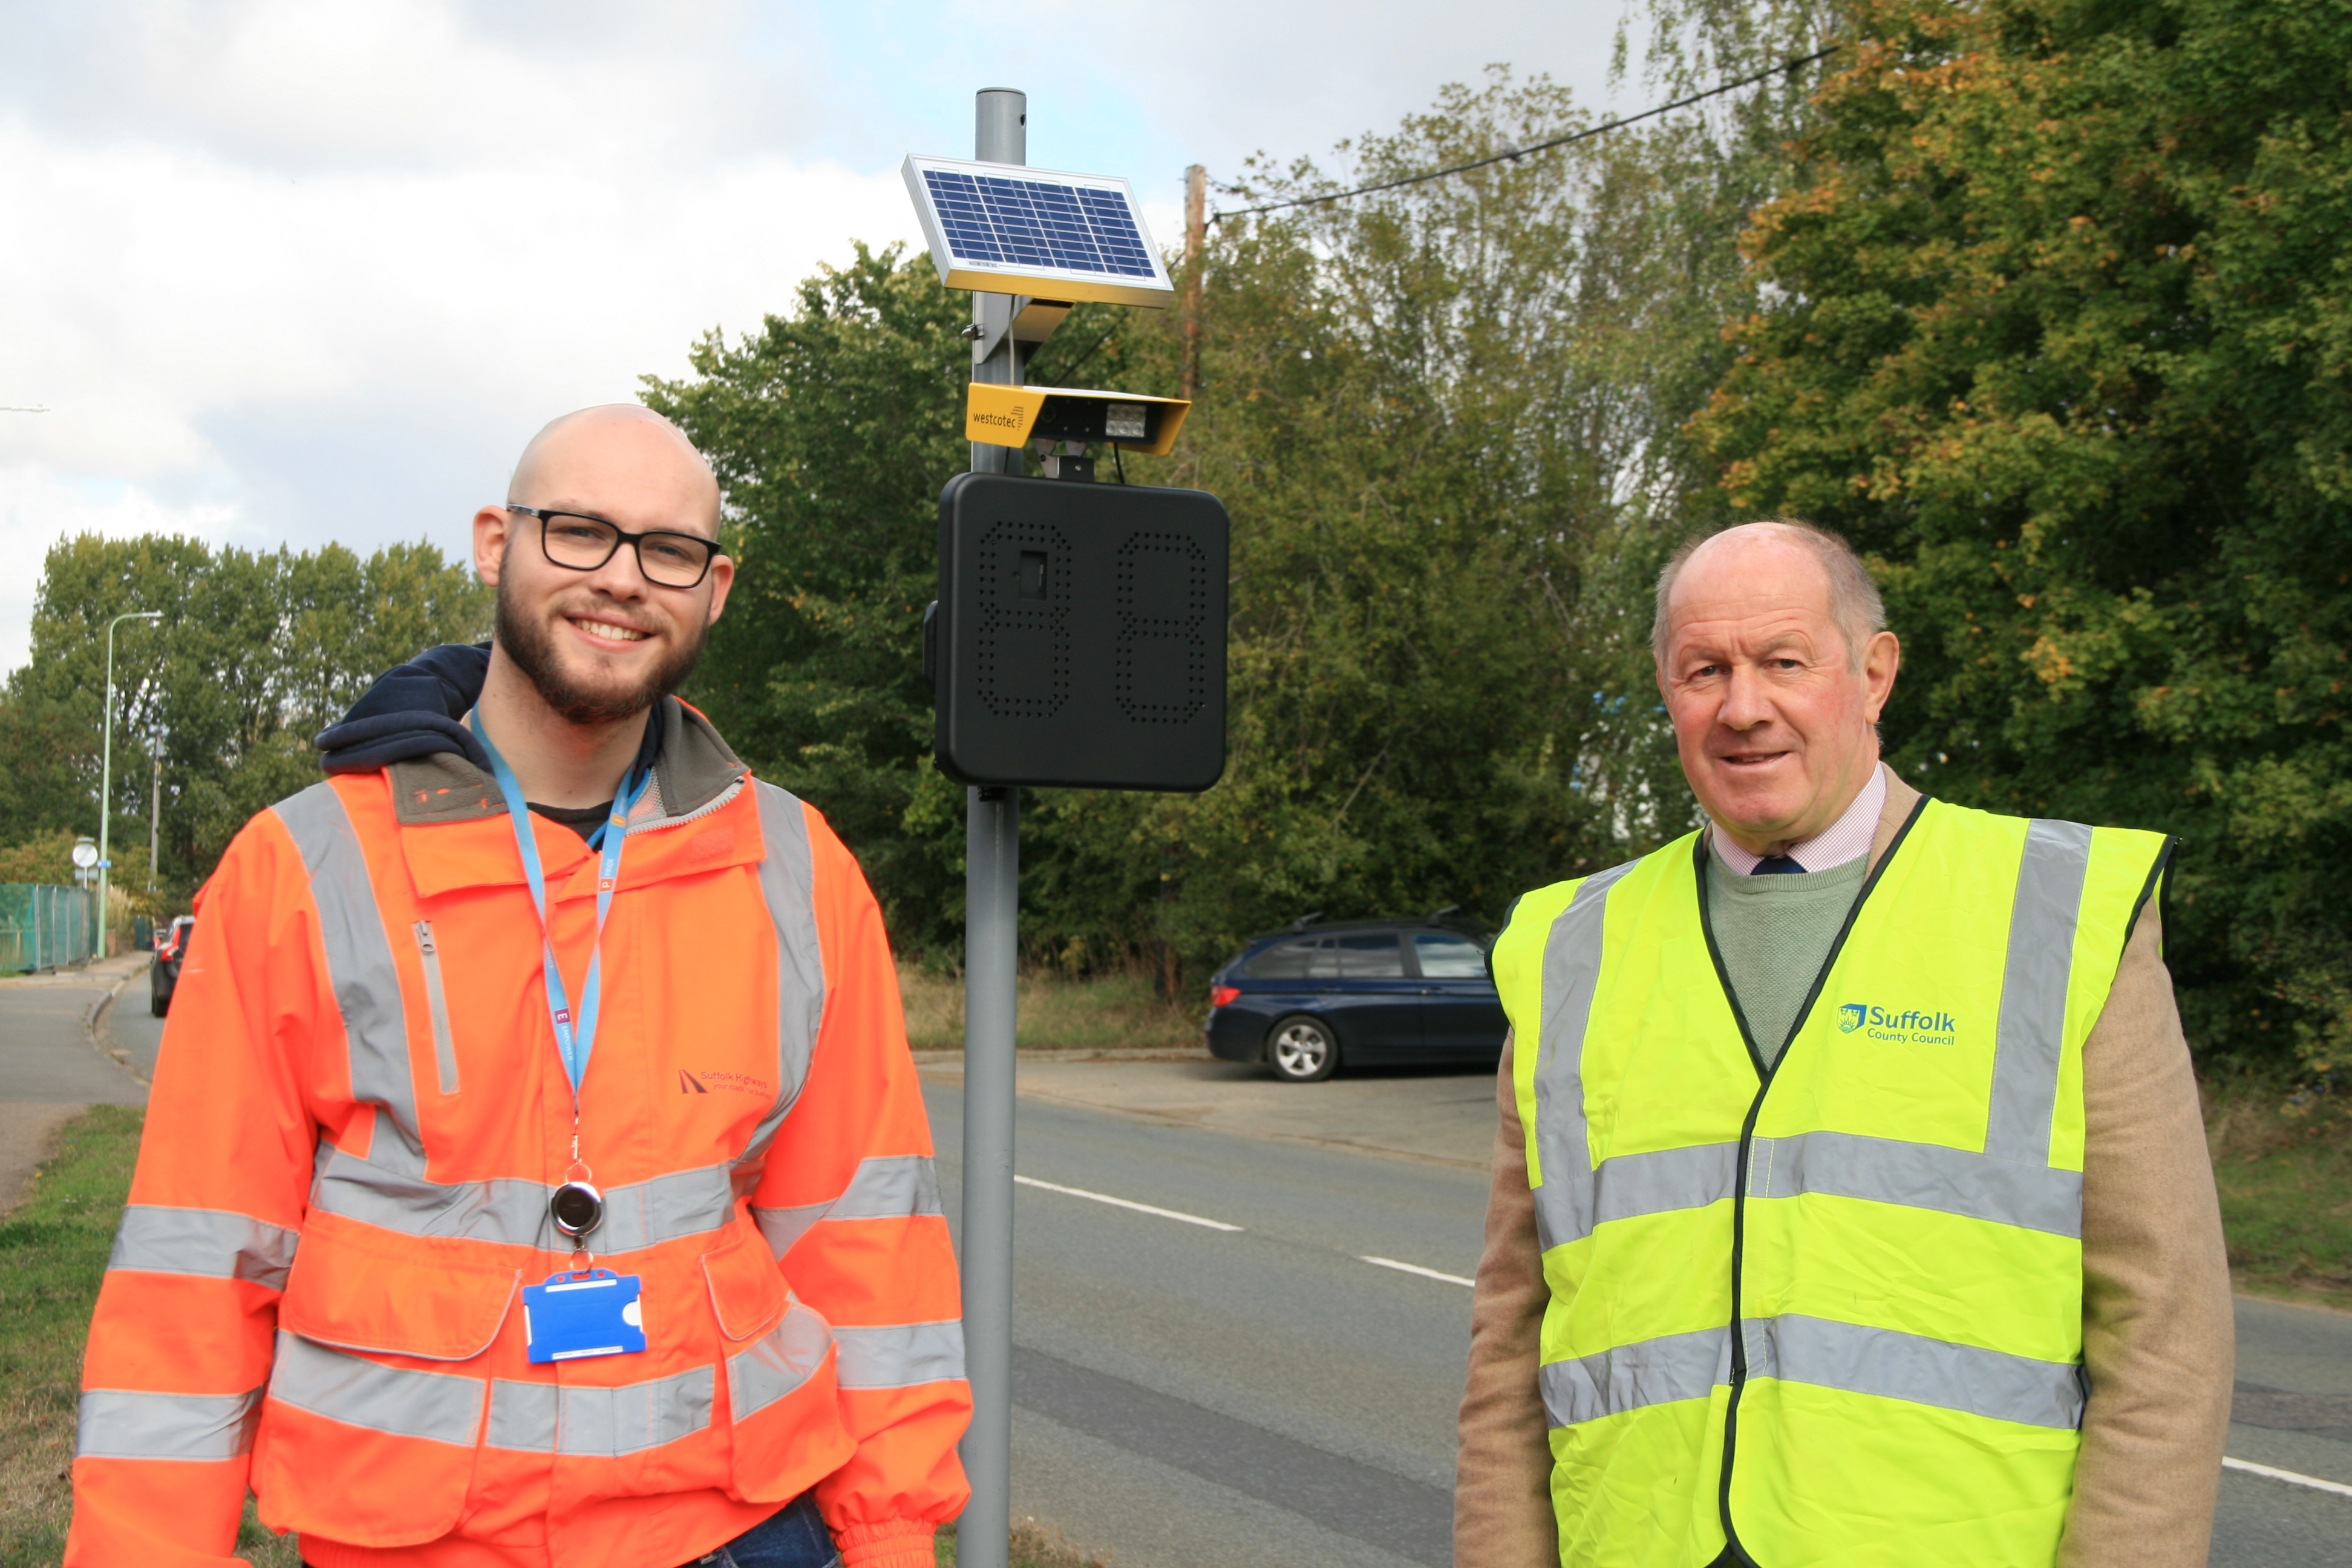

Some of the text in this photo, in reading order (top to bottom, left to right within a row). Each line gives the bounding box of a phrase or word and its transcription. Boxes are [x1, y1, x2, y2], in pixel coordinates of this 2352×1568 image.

[973, 413, 1016, 428] westcotec
[605, 858, 614, 877] PRIDE
[1869, 1005, 1956, 1032] Suffolk
[557, 1012, 573, 1061] E EMPOWER
[1867, 1028, 1955, 1046] County Council
[701, 1071, 734, 1082] Suffolk
